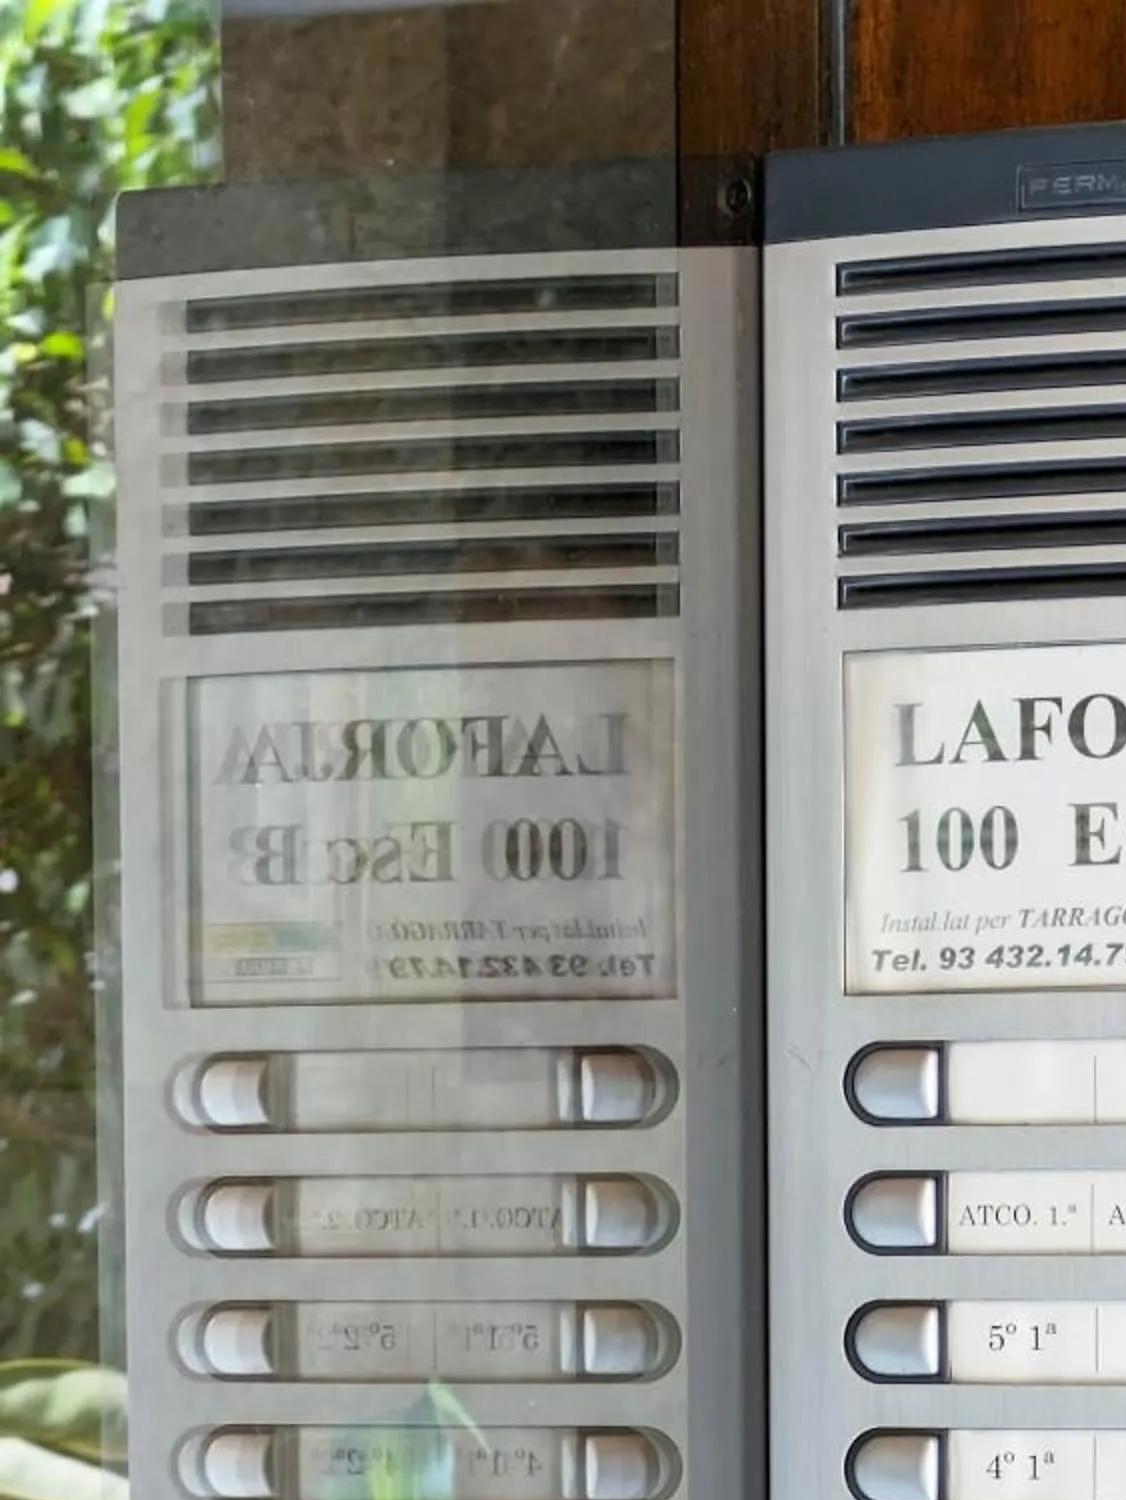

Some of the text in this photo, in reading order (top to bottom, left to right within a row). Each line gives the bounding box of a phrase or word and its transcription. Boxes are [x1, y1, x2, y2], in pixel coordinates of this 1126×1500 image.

[896, 804, 1020, 874] 100
[974, 913, 1011, 936] per
[871, 948, 928, 973] Tel.
[938, 945, 976, 971] 93
[958, 1203, 1039, 1227] ATCO.
